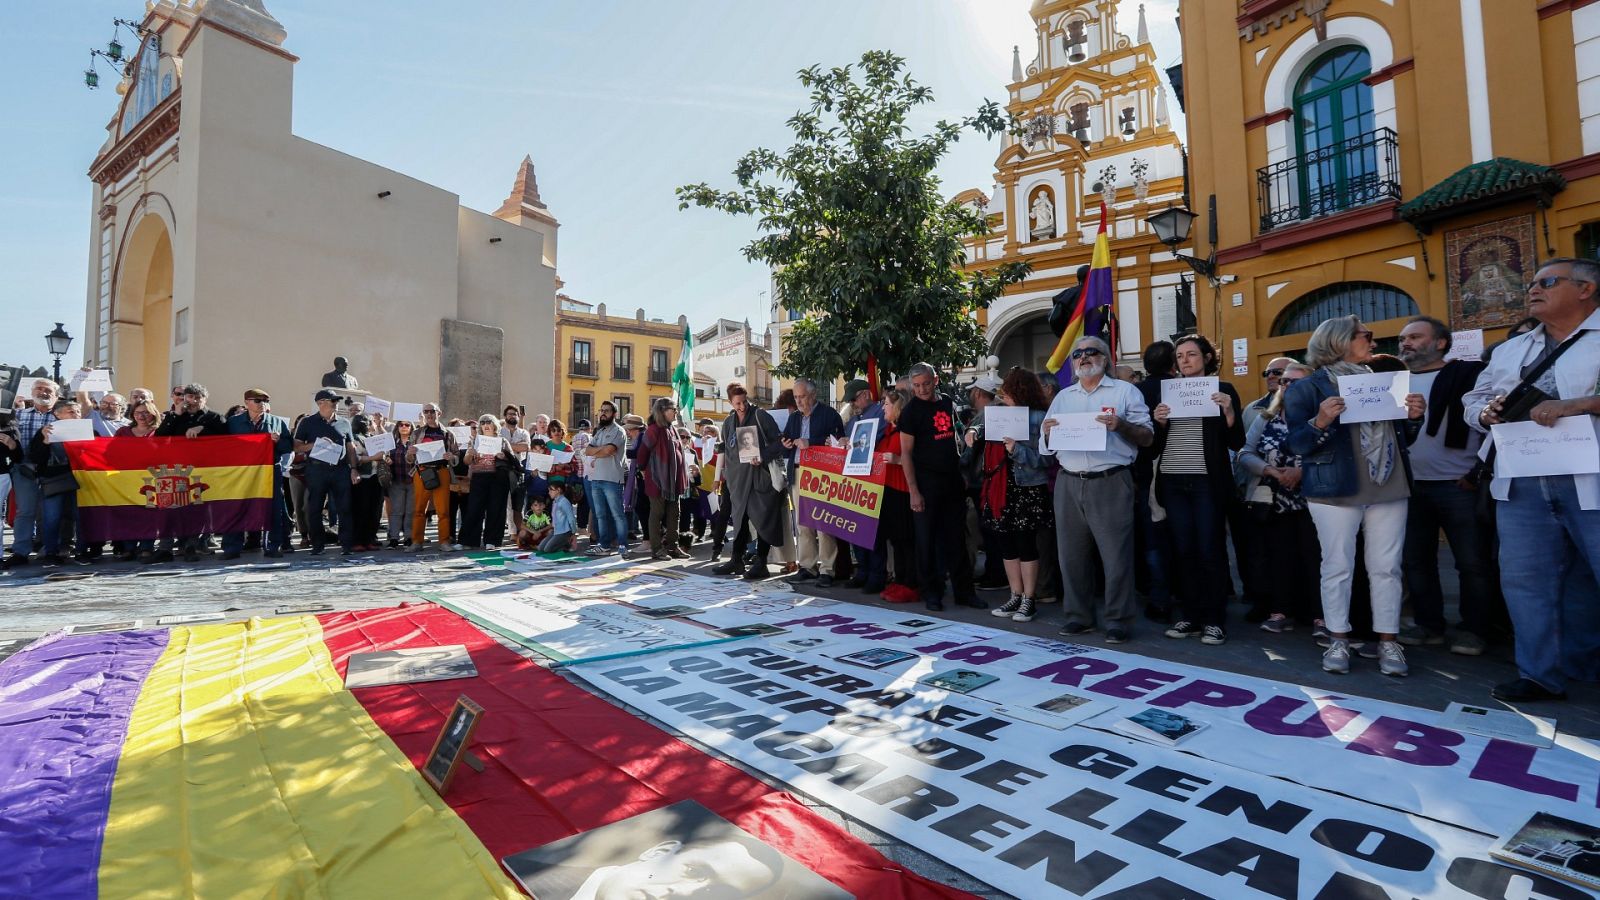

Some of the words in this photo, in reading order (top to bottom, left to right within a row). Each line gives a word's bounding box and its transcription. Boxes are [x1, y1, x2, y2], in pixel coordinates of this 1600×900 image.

[811, 505, 857, 533] Utrera
[600, 665, 680, 695] LA
[668, 656, 900, 738] QUEIPO
[900, 737, 1048, 796] DE
[722, 647, 915, 709] FUERA
[915, 704, 1013, 742] EL
[773, 613, 920, 640] por
[913, 635, 1021, 665] la
[1018, 656, 1600, 810] REPÚBL
